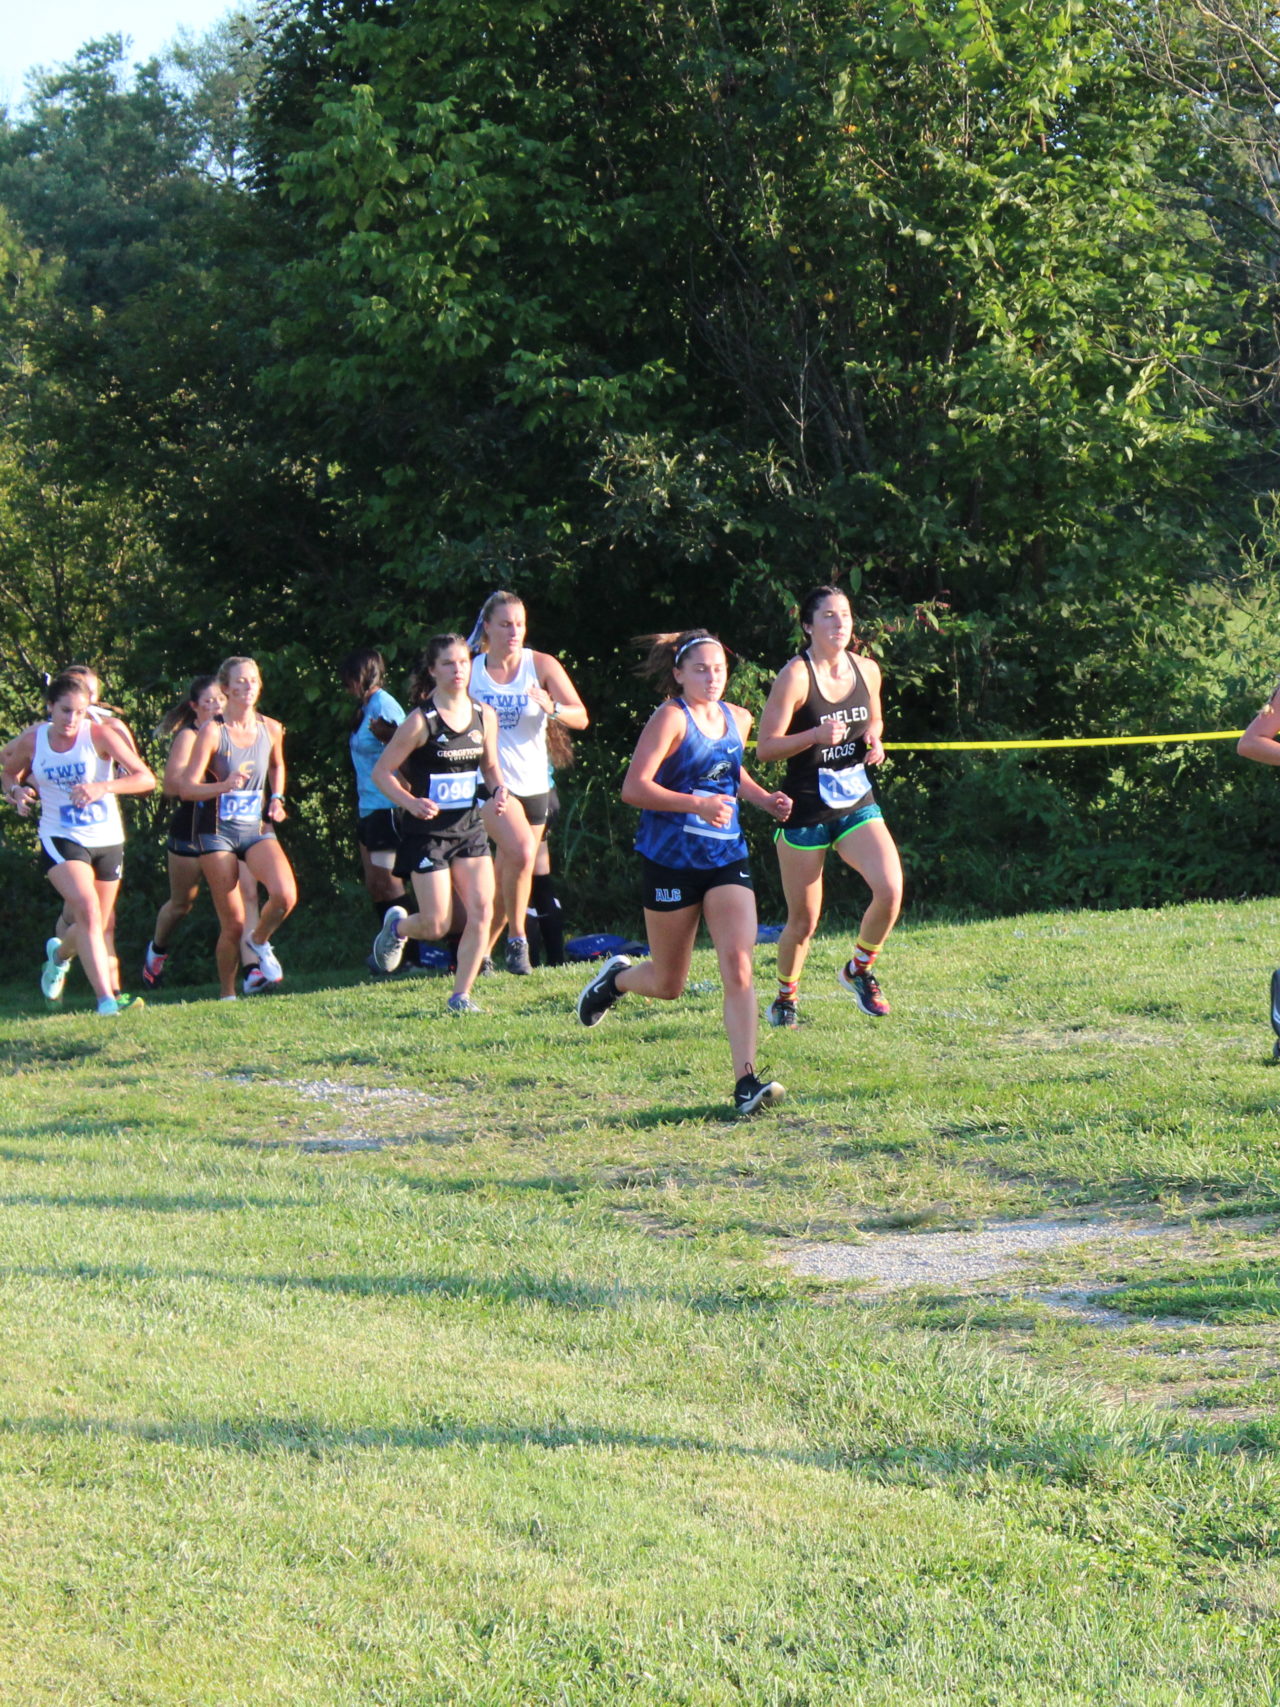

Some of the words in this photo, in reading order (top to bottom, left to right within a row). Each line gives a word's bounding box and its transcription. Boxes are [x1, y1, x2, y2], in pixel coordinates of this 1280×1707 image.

[483, 694, 529, 707] TWU
[821, 743, 856, 763] TACOS
[43, 762, 86, 780] TWU
[437, 781, 472, 800] 096
[655, 887, 682, 903] ALC
